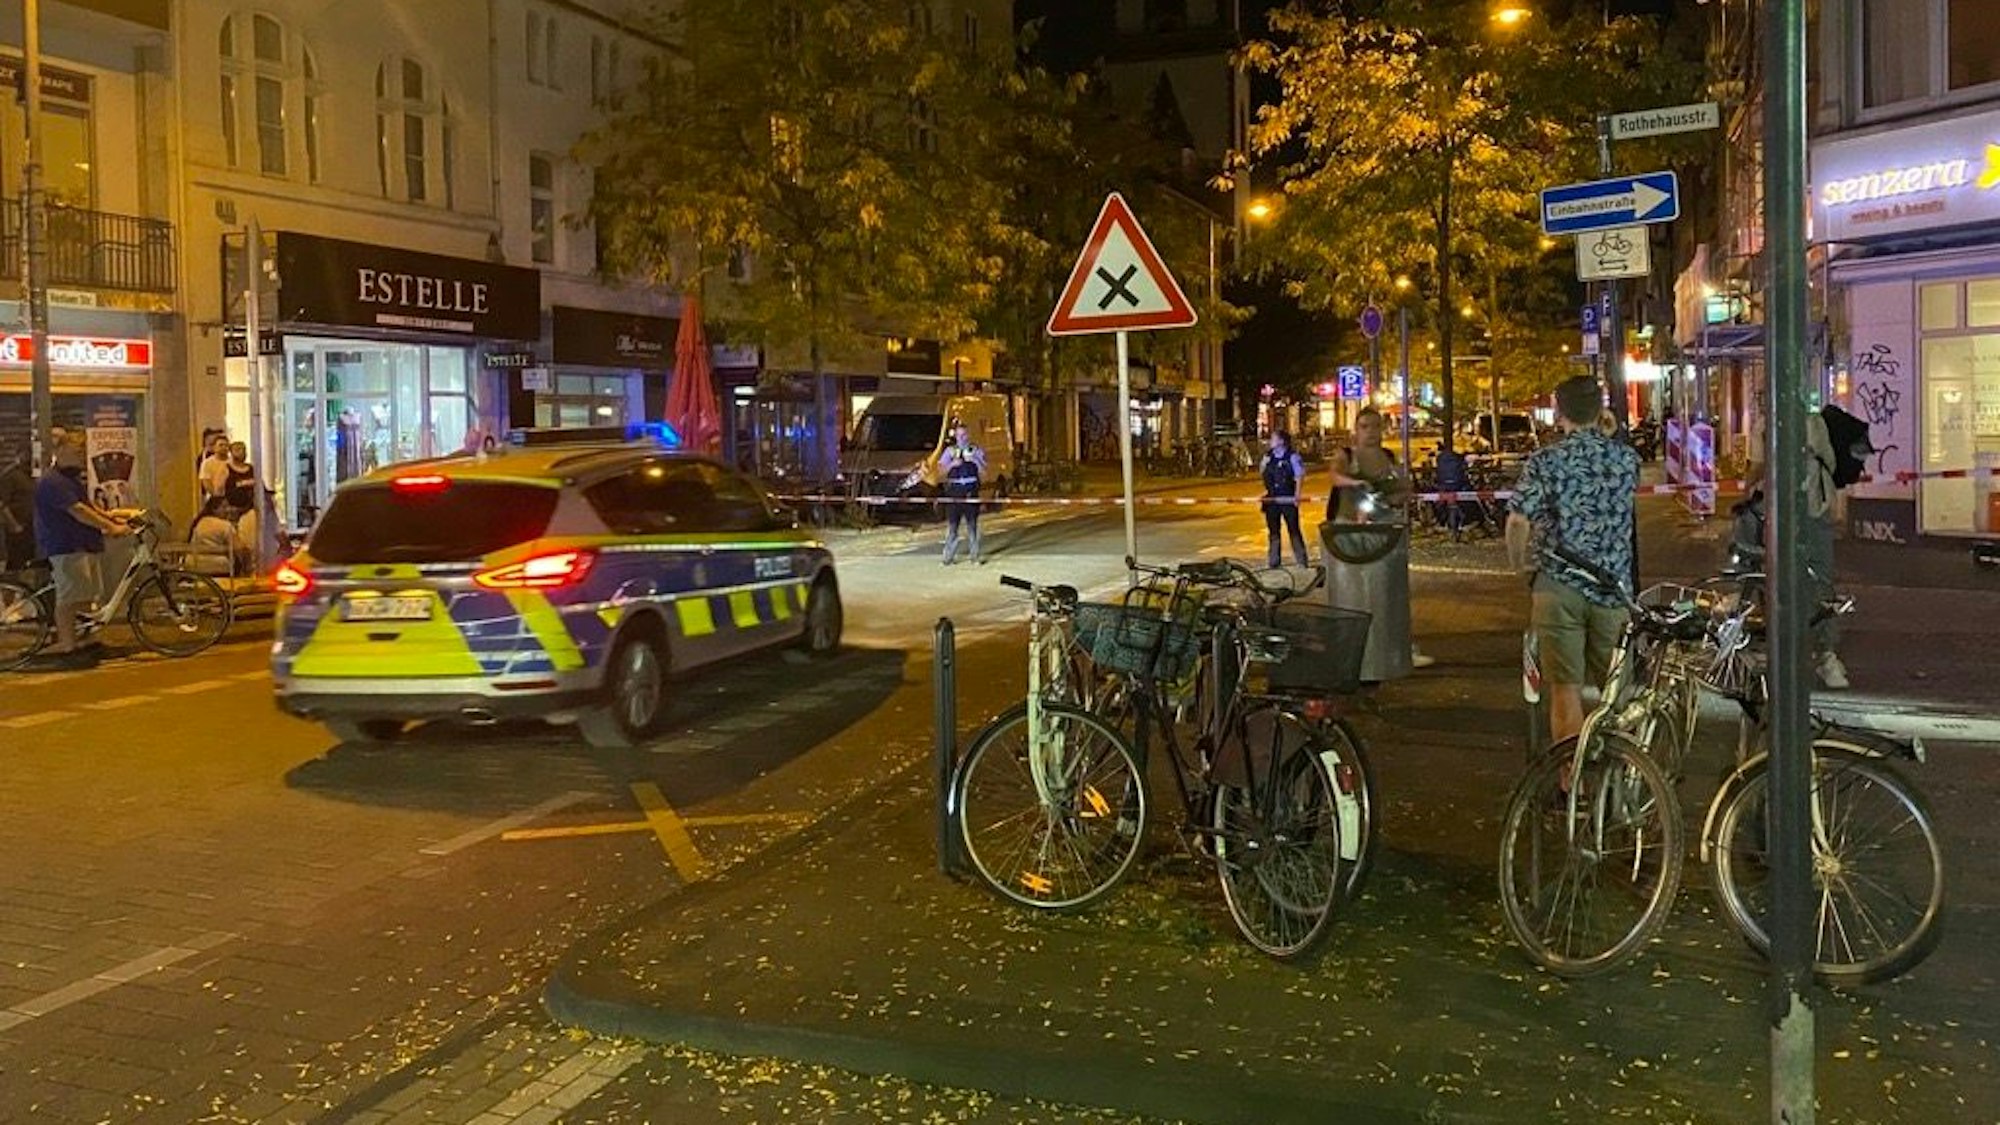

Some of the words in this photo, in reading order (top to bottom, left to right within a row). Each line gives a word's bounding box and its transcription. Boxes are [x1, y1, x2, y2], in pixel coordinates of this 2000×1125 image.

[1619, 109, 1712, 132] Rothehausstr.
[1821, 159, 1969, 205] senzera
[1550, 196, 1637, 217] Einbahnstraße
[358, 268, 489, 314] ESTELLE
[49, 341, 125, 364] nited
